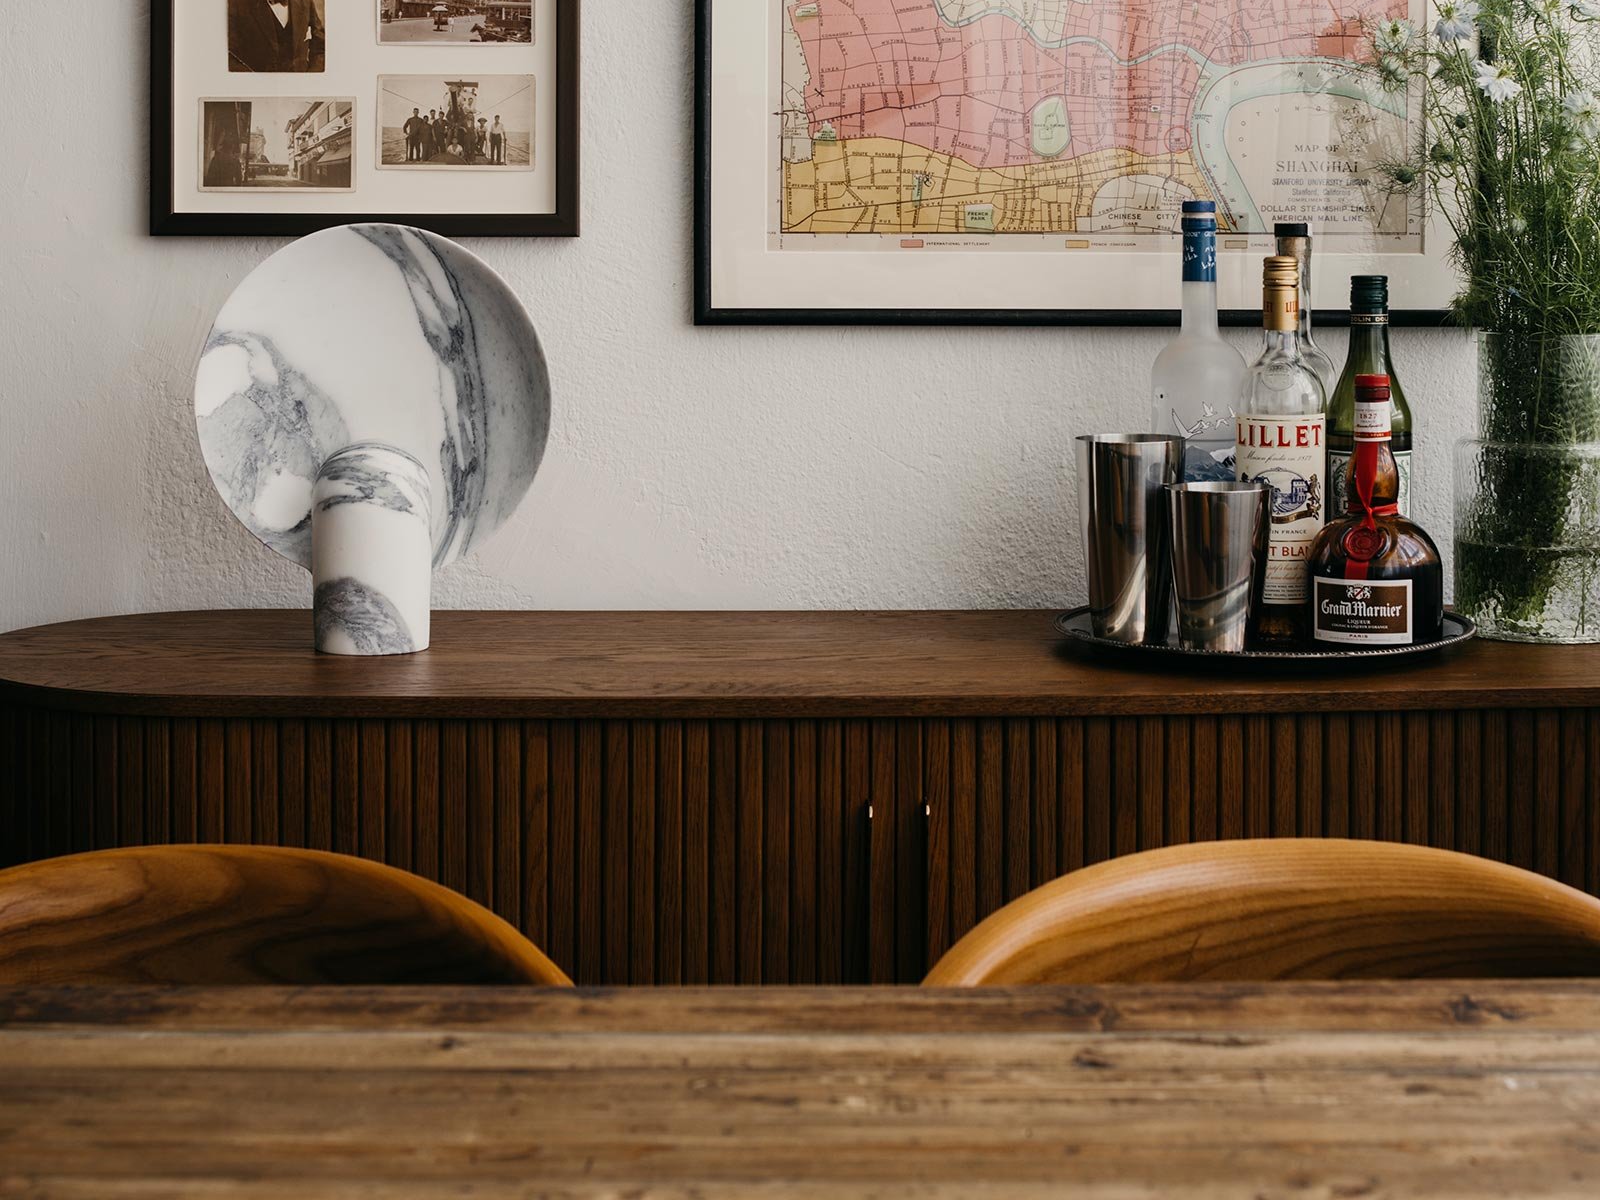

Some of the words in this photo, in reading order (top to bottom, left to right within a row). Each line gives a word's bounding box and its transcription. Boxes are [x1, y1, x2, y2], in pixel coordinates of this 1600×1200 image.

[1294, 144, 1320, 153] MAP
[1324, 144, 1340, 153] OF
[1275, 160, 1359, 174] SHANGHAI
[1271, 178, 1304, 186] STANFORD
[1260, 205, 1297, 213] DOLLAR
[1300, 205, 1347, 213] STEAMSHIP
[1350, 205, 1376, 213] LINES
[1271, 214, 1313, 222] AMERICAN
[1317, 214, 1339, 222] MAIL
[1342, 214, 1363, 222] LINE
[1237, 423, 1322, 448] LILLET
[1347, 618, 1371, 626] LIQUEUR
